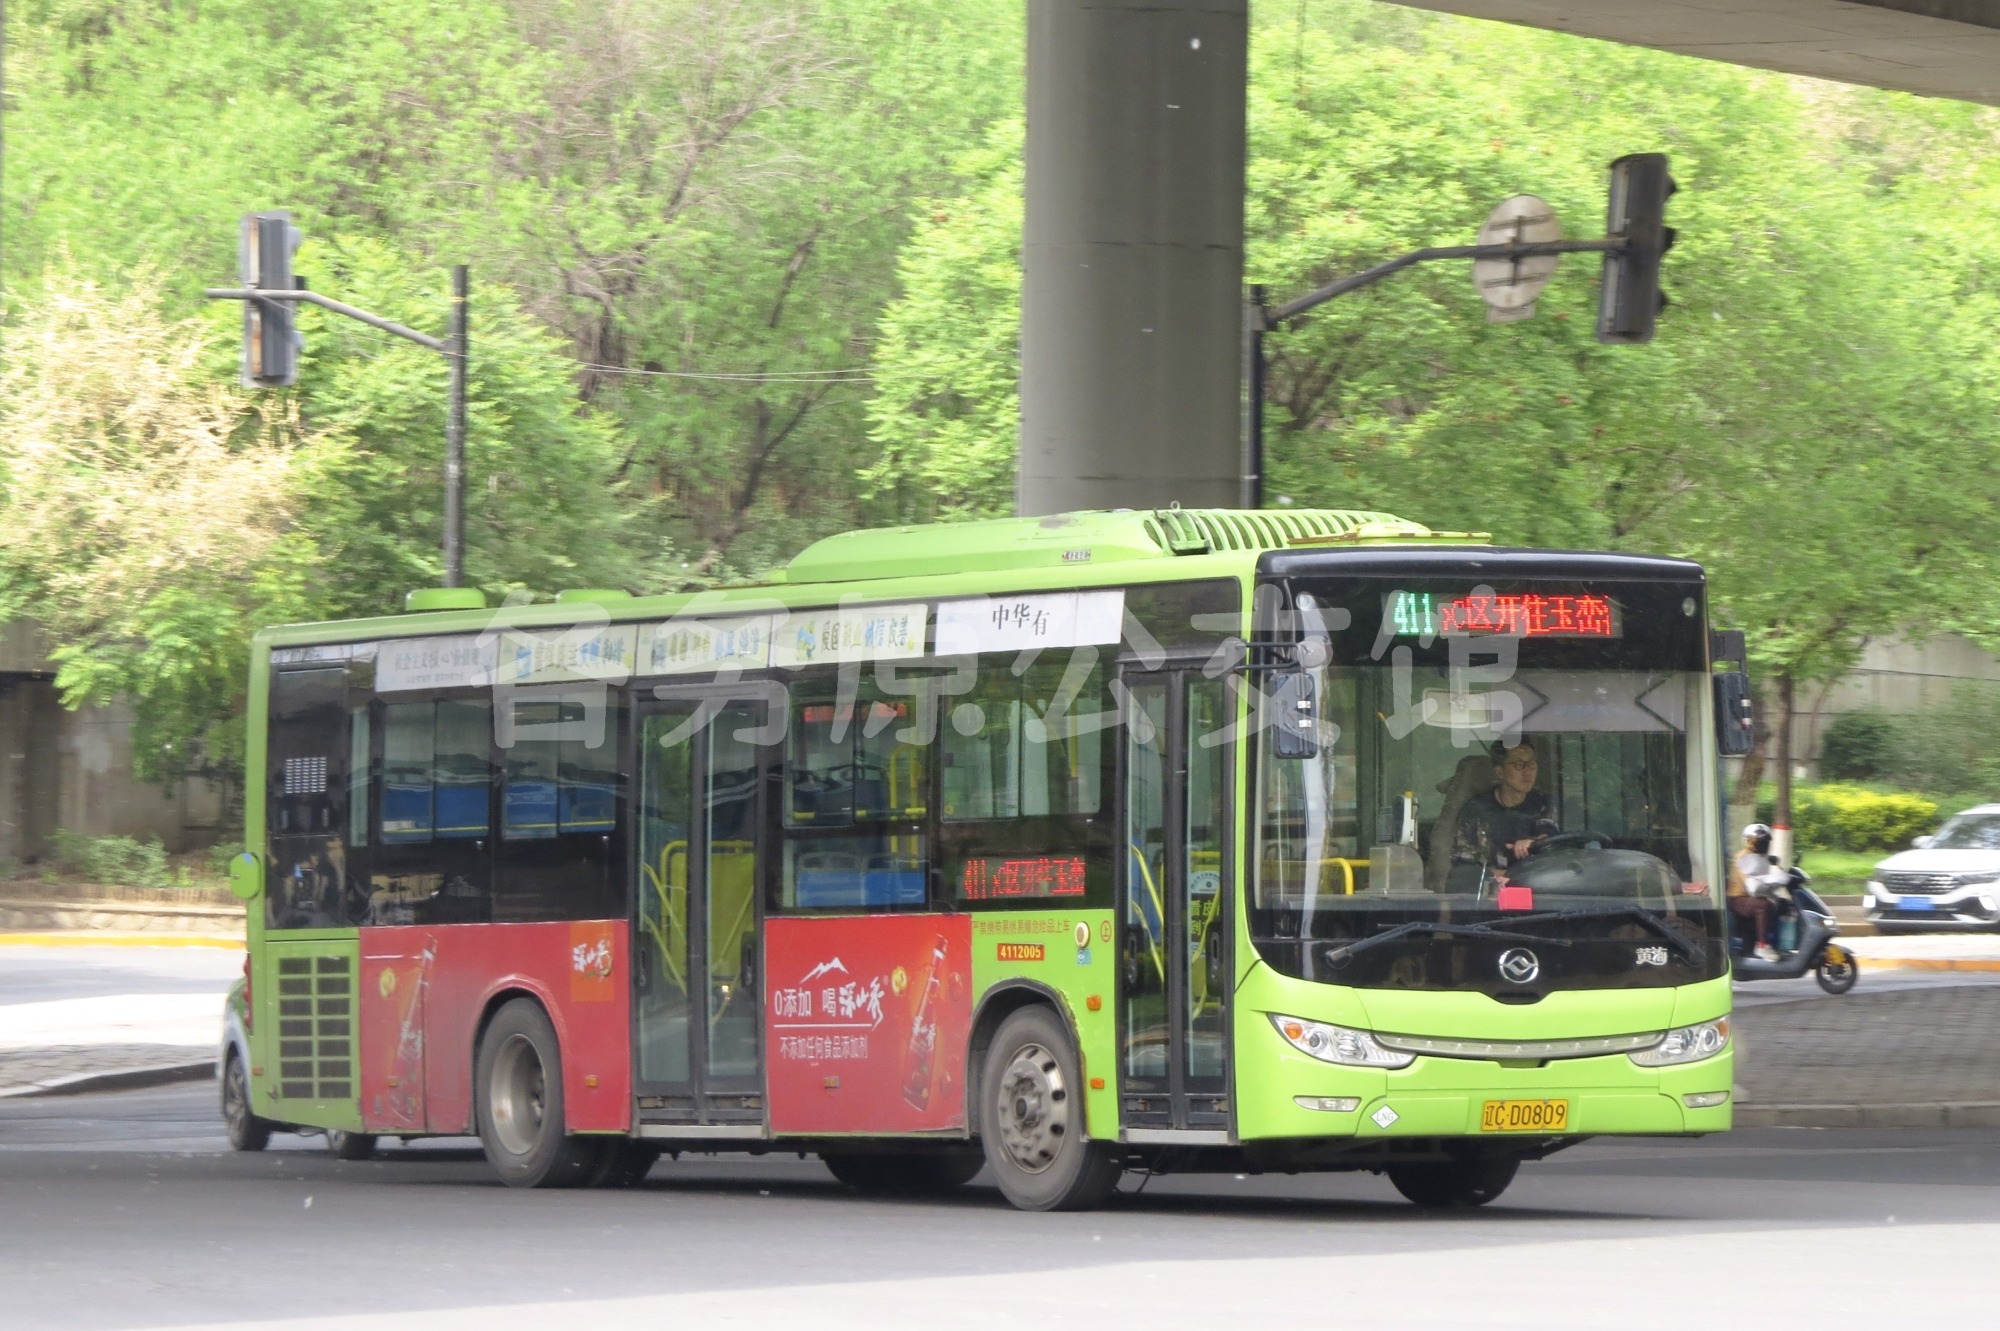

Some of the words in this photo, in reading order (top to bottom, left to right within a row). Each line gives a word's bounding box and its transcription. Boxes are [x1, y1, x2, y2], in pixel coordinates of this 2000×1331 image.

[992, 603, 1050, 636] 中华有
[1393, 592, 1433, 634] 411
[1000, 945, 1042, 959] 4112005
[1635, 946, 1668, 966] 黄海
[774, 987, 812, 1018] 0添加
[780, 1035, 869, 1060] 不添加任何食品添加剂
[1375, 1111, 1396, 1122] LNG
